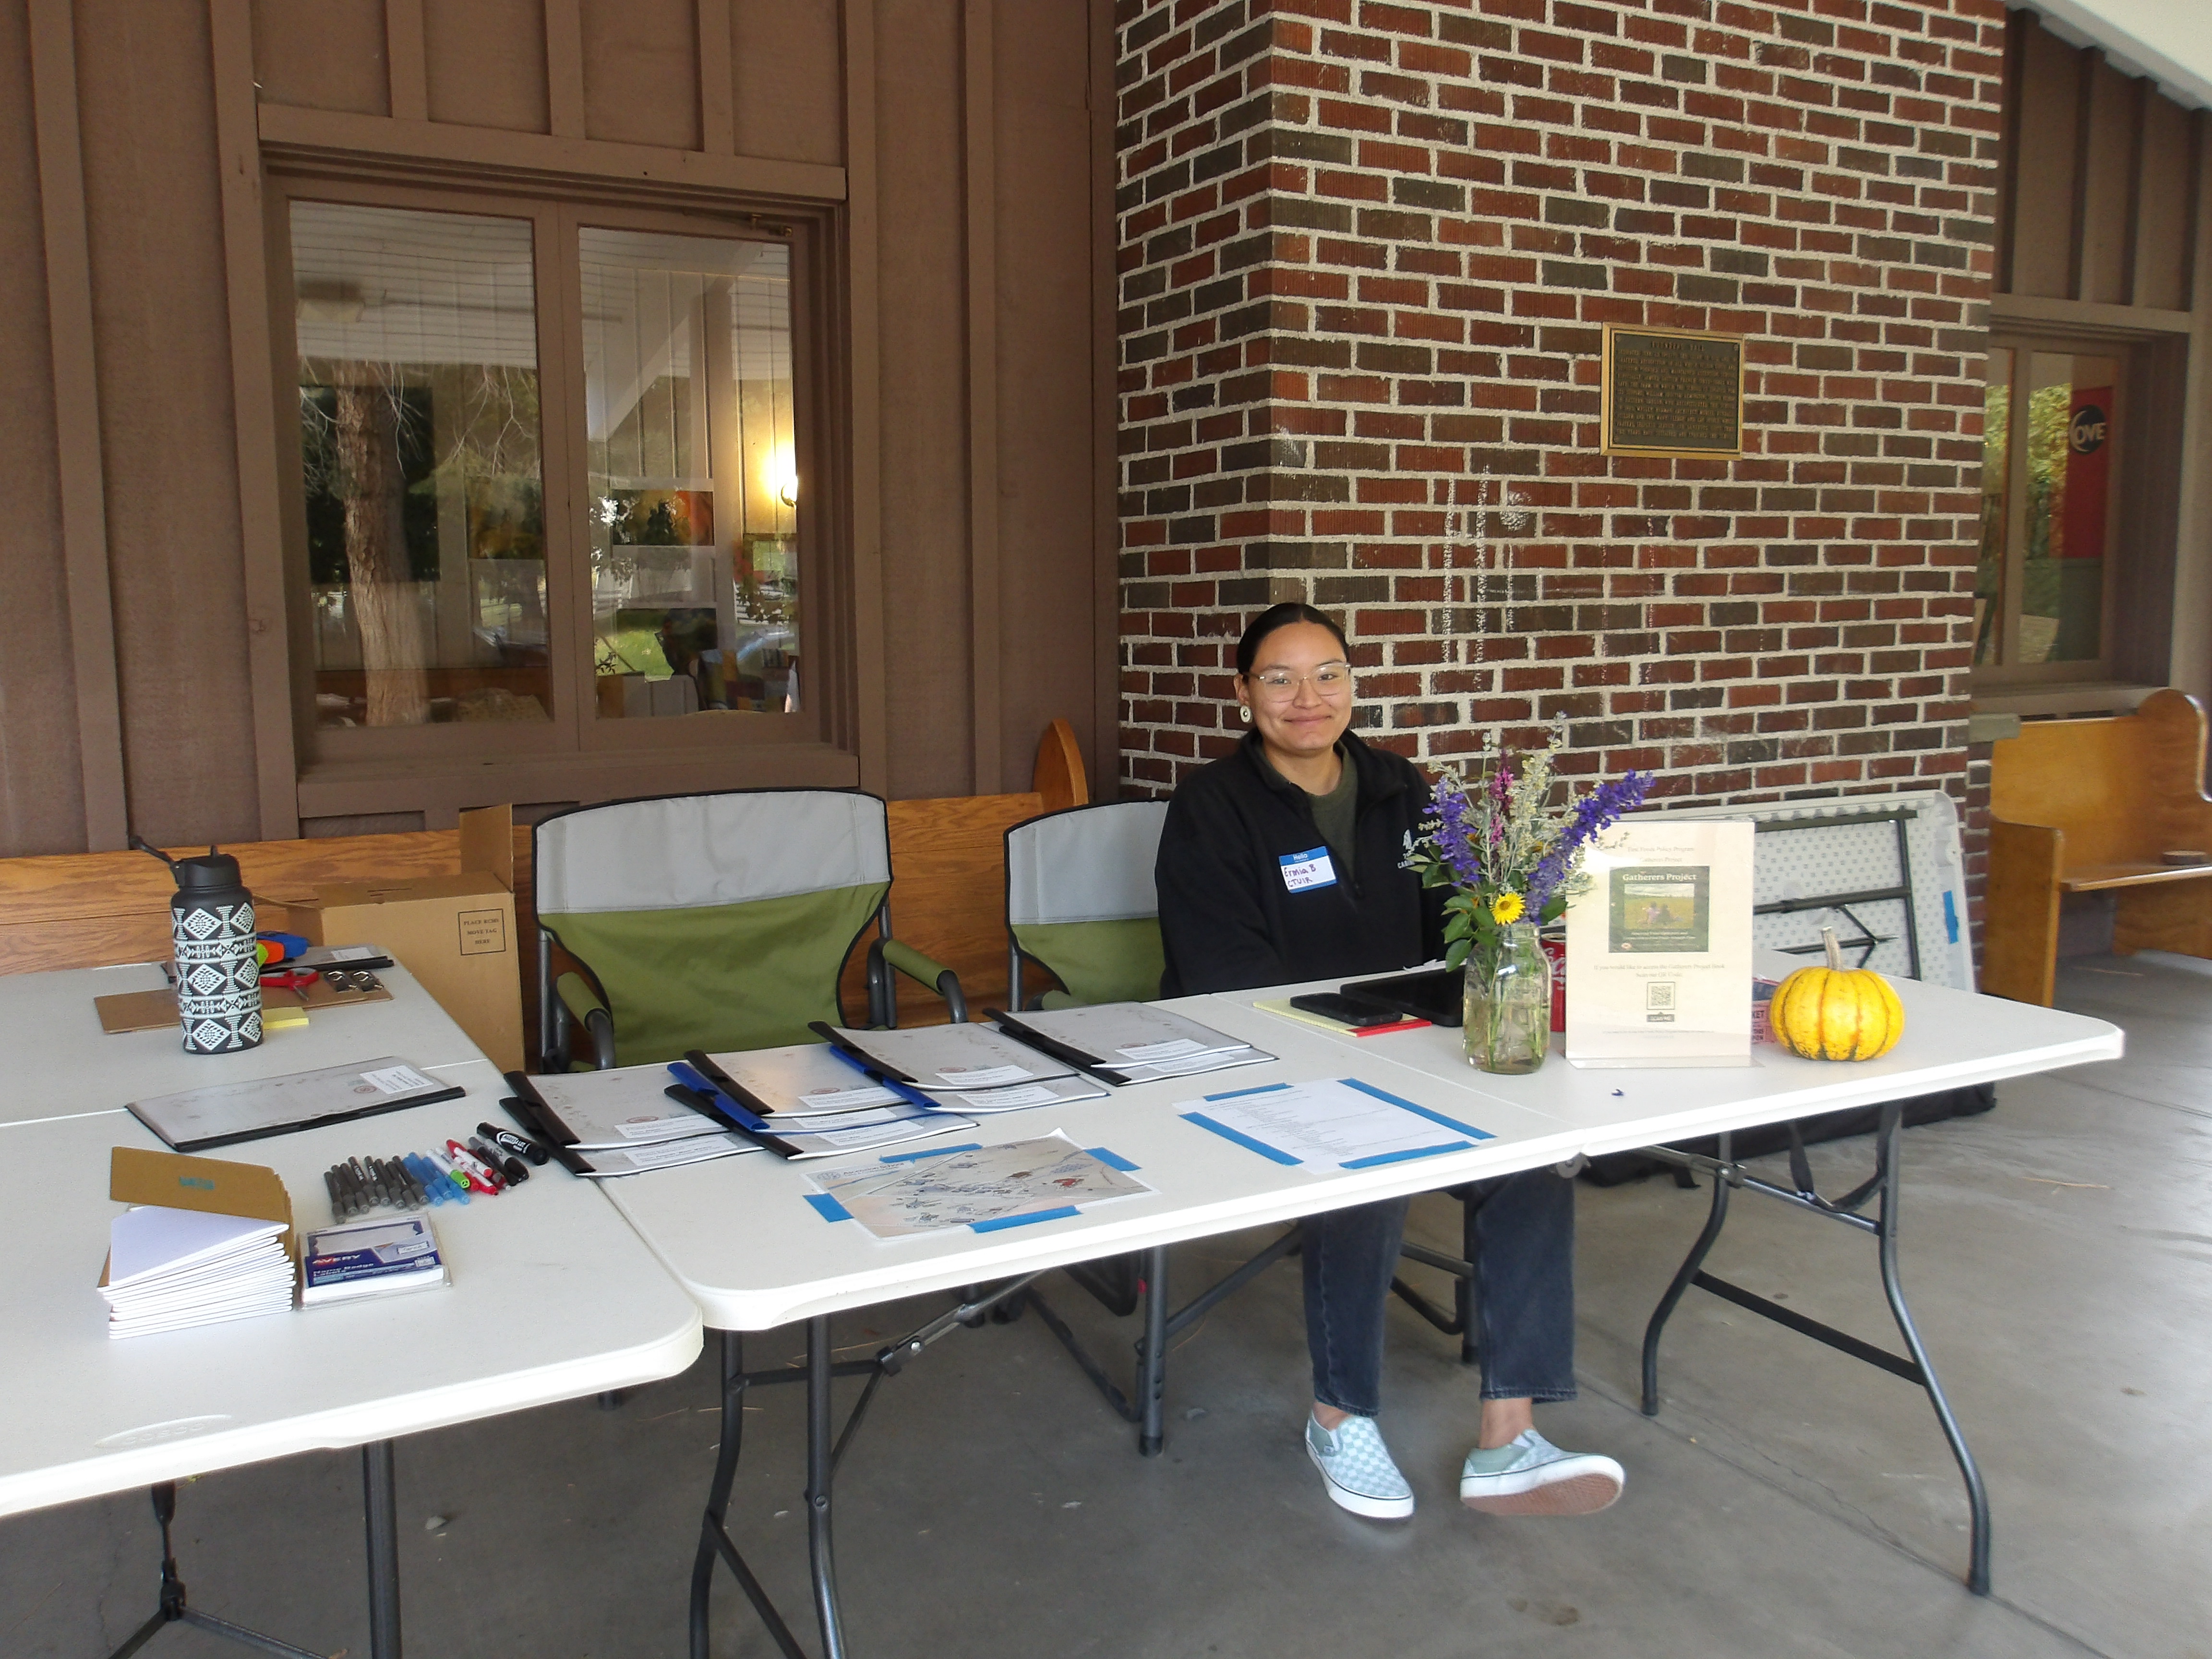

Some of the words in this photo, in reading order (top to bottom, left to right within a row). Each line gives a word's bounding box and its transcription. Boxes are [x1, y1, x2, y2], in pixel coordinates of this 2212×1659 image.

[1284, 867, 1308, 877] Ermia
[1309, 864, 1316, 872] B
[1288, 877, 1312, 887] CTUIR
[1667, 873, 1697, 882] Project
[312, 1254, 361, 1263] AVERY
